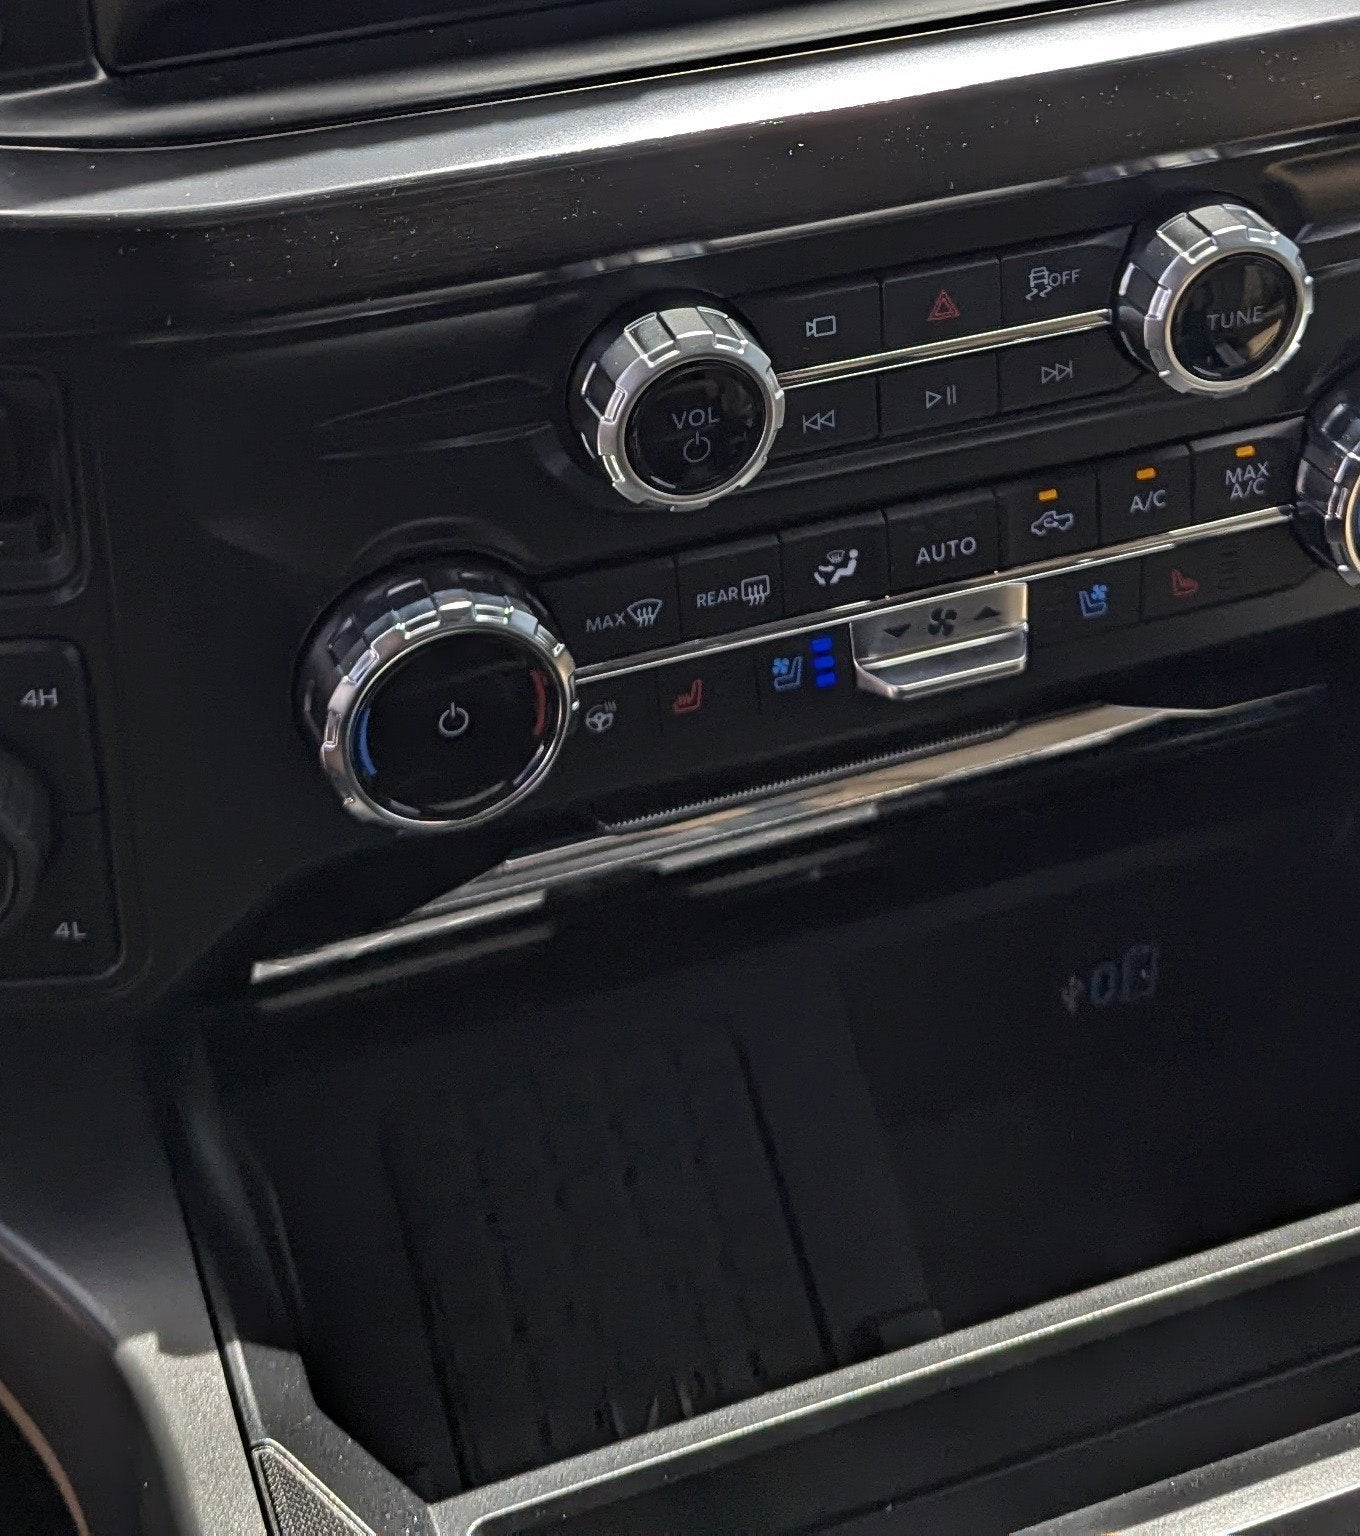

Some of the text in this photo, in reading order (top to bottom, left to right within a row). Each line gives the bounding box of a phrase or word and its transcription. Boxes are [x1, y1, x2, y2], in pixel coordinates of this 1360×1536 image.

[1049, 268, 1081, 286] OFF
[1207, 306, 1264, 328] TUNE
[672, 407, 720, 430] VOL
[1226, 461, 1269, 485] MAX
[1230, 478, 1264, 499] A/C
[1130, 489, 1167, 512] A/C
[916, 536, 976, 564] AUTO
[696, 586, 739, 608] REAR
[585, 610, 628, 633] MAX
[20, 688, 58, 707] 4H
[54, 921, 86, 939] 4L
